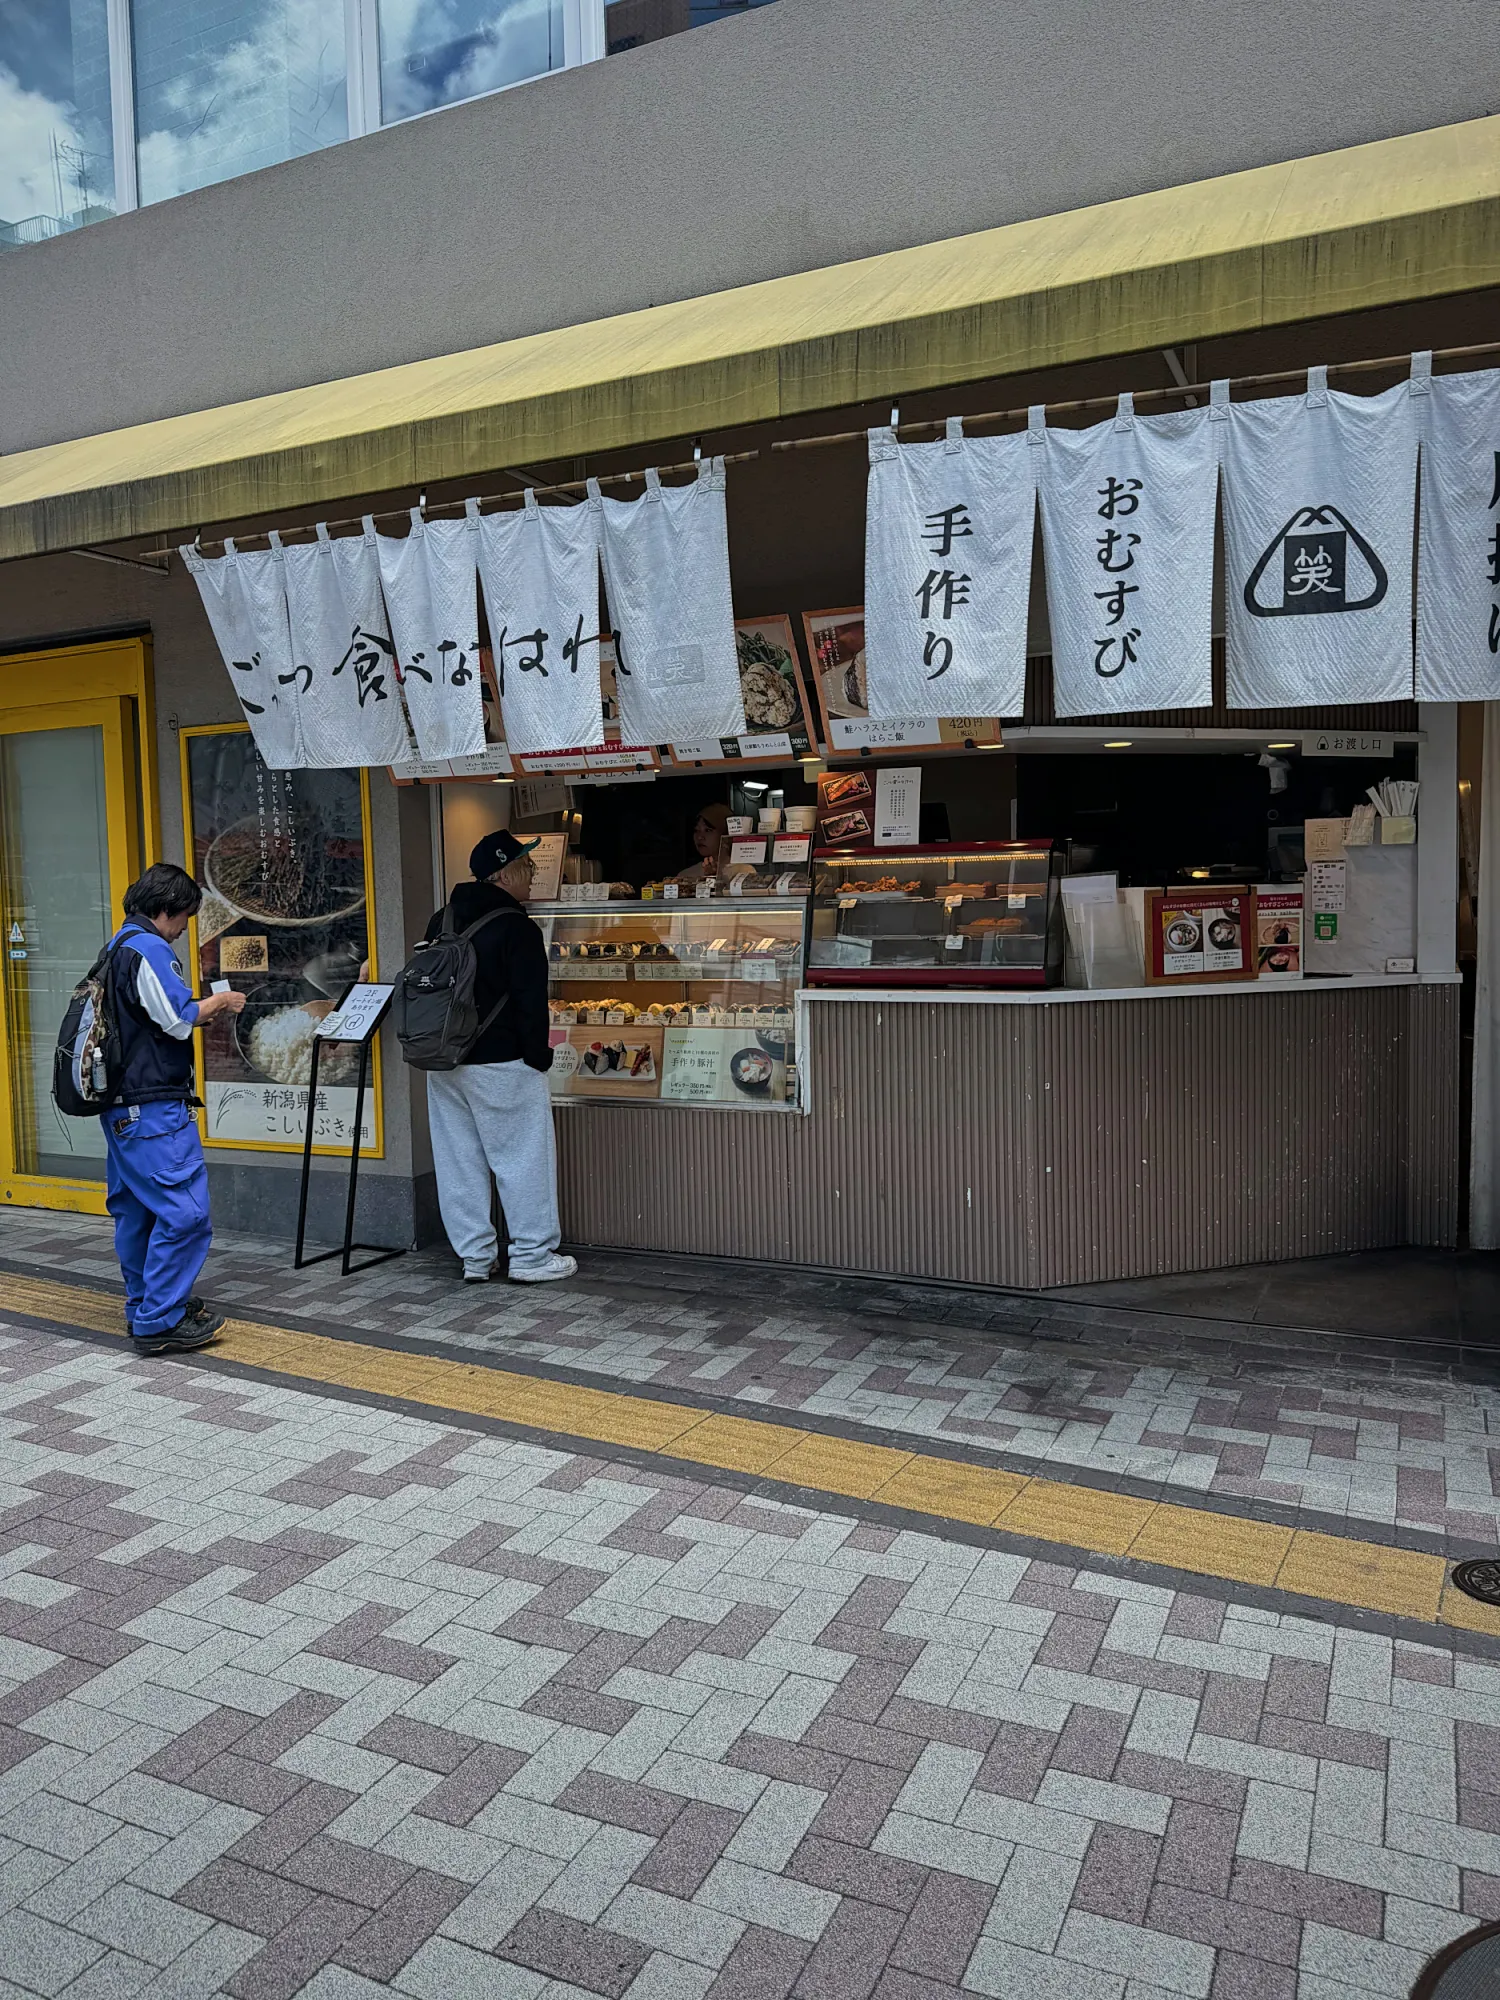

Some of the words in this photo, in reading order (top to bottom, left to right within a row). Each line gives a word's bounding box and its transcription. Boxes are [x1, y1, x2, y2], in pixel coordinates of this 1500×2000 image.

[1093, 476, 1145, 679] おむすび
[915, 503, 975, 682] 手作り
[844, 720, 926, 735] 鮭ハラスとイクラの
[948, 717, 983, 729] 420円
[868, 731, 906, 743] はらこ飯
[1333, 737, 1383, 751] お渡し口
[364, 989, 379, 997] 2F
[670, 1057, 716, 1068] 手作り豚汁
[262, 1088, 330, 1111] 新潟県産
